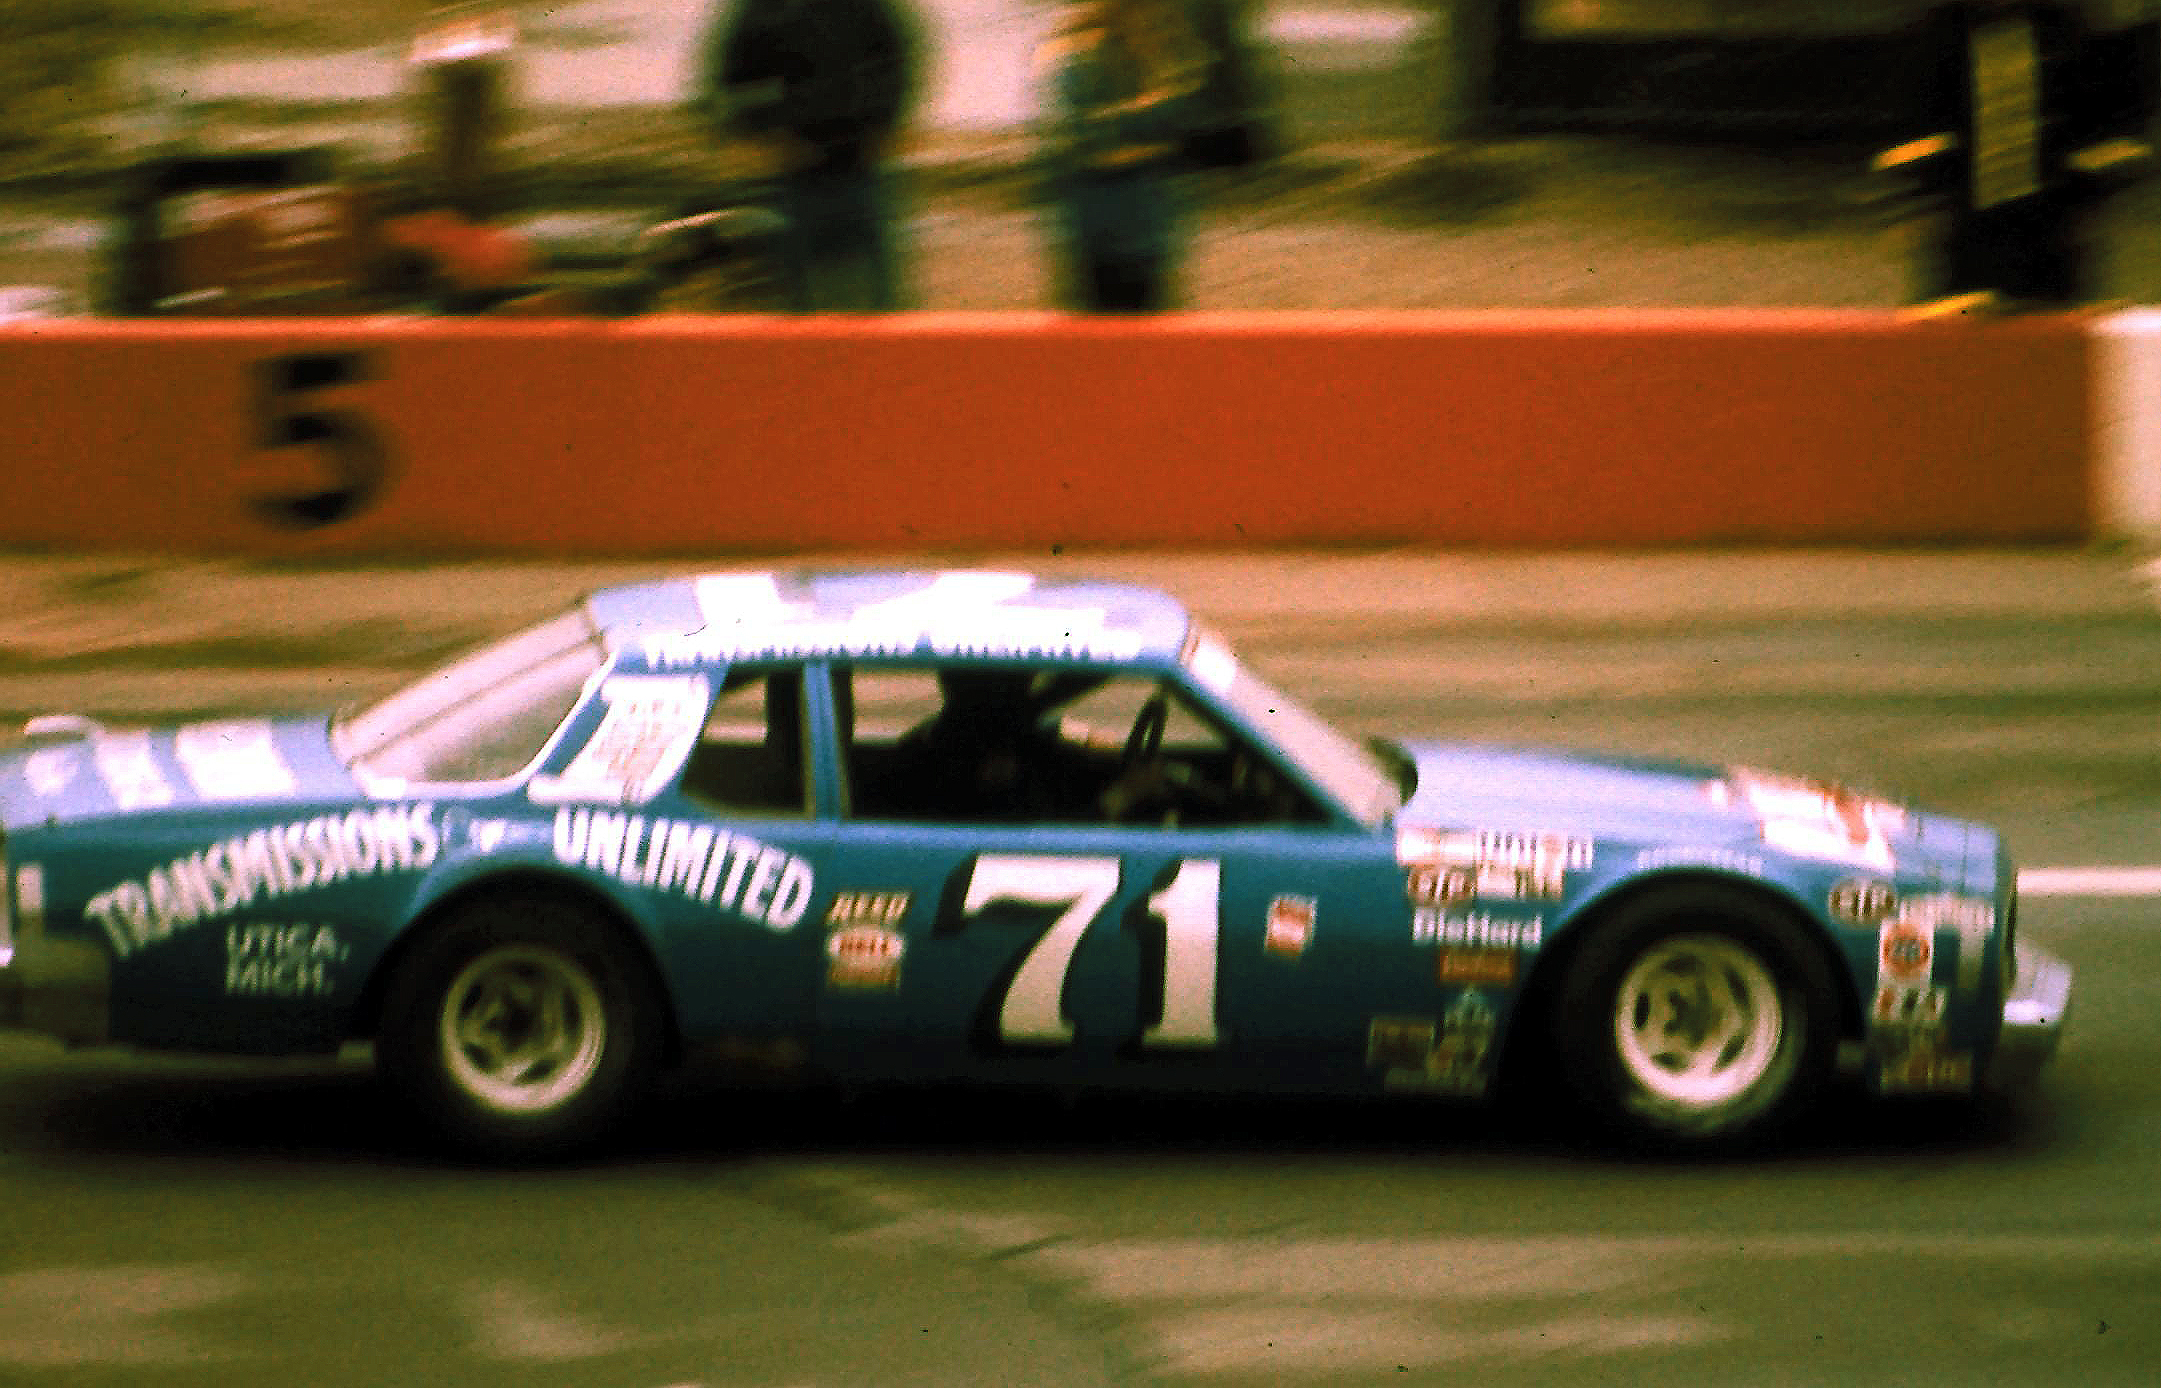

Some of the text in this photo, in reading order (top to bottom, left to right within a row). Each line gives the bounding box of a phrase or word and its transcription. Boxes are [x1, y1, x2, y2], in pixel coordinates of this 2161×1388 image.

[240, 350, 395, 533] 5
[83, 801, 815, 958] TRANSMISSIONS UNLIMITED
[958, 853, 1222, 1050] 71
